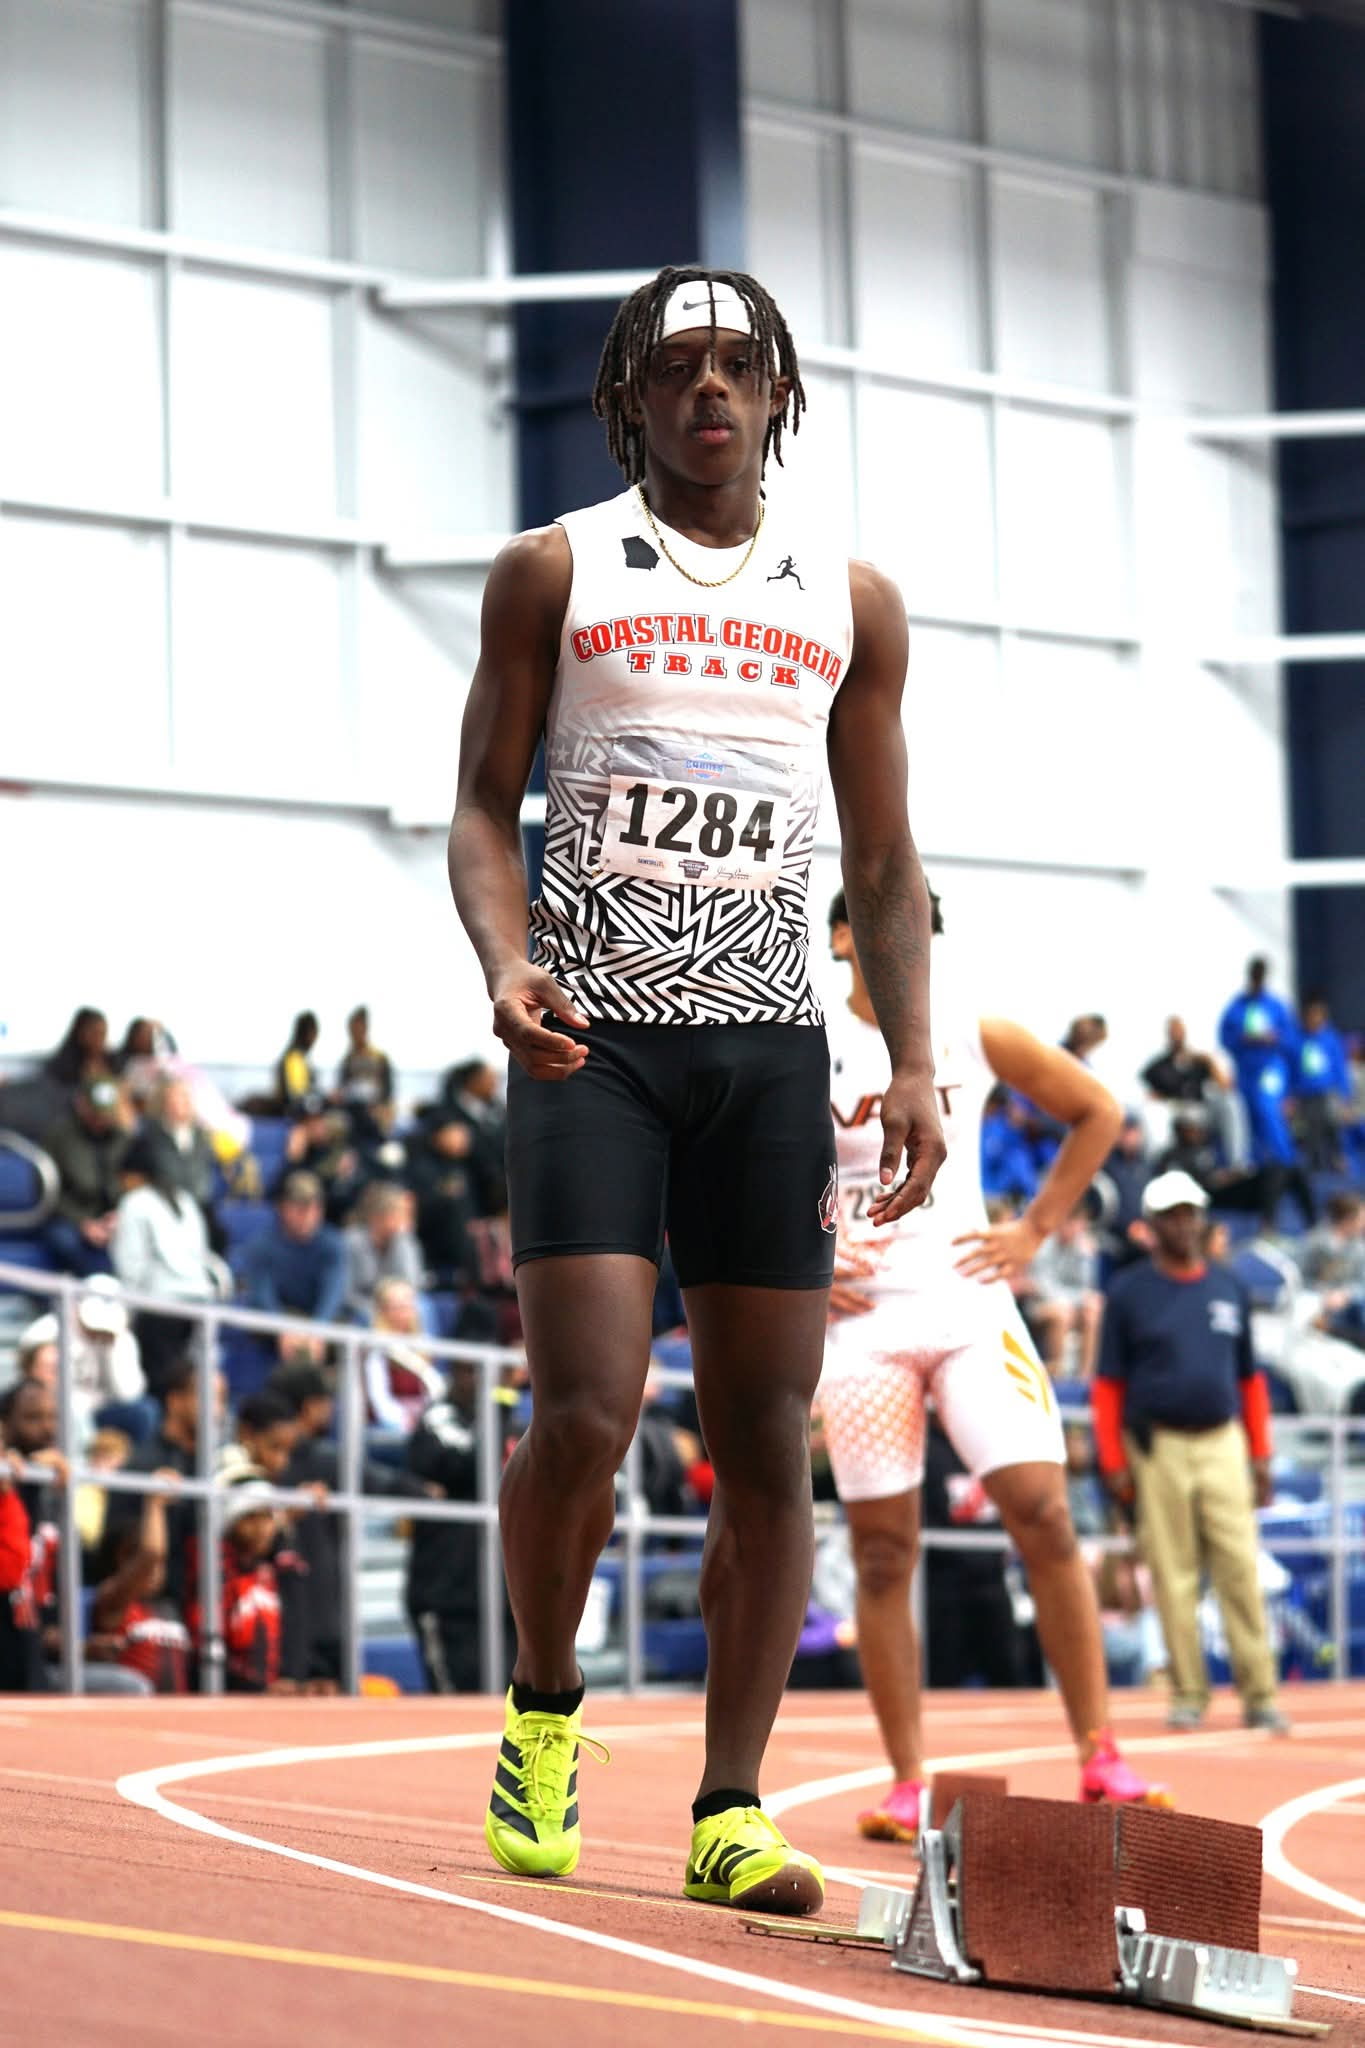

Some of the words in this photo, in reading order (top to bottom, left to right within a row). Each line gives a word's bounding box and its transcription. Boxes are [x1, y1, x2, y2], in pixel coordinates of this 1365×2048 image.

[571, 614, 717, 662] COASTAL
[720, 617, 844, 690] GEORGIA
[627, 651, 800, 689] TRACK
[619, 783, 775, 862] 1284
